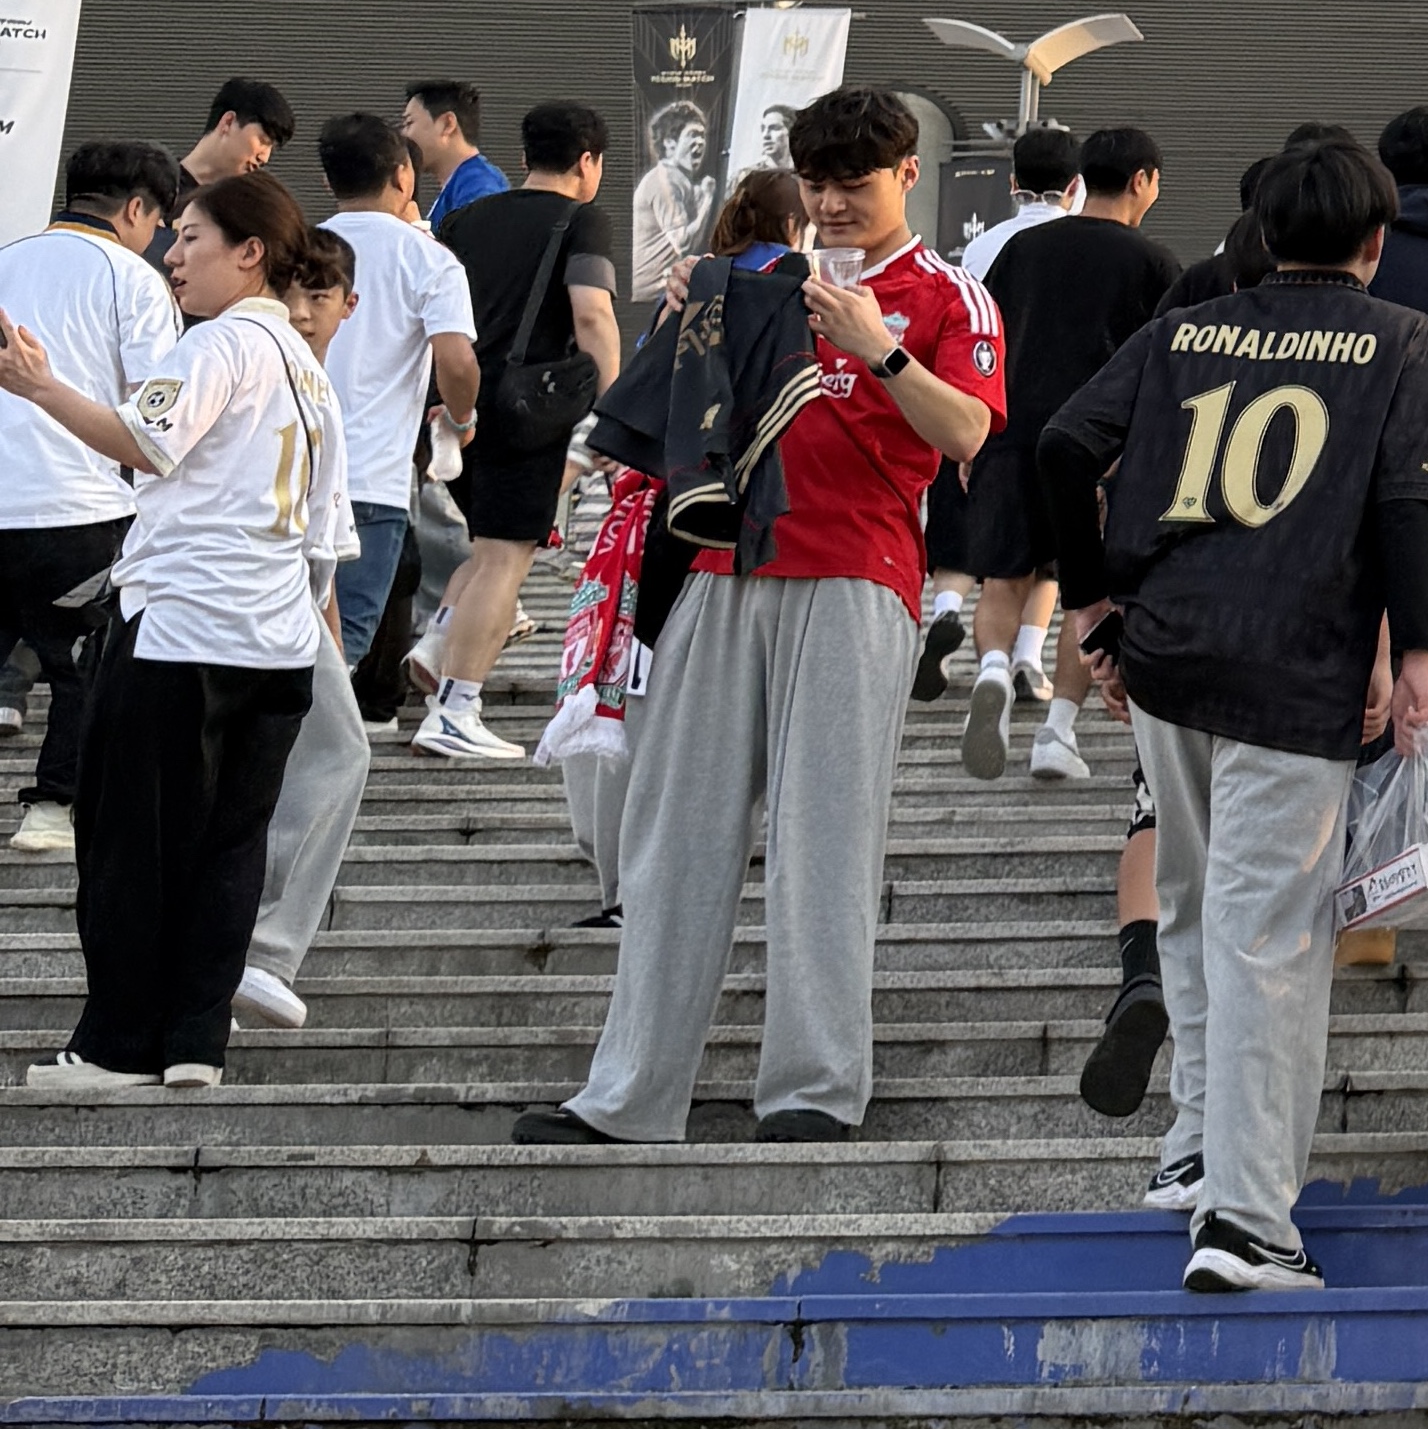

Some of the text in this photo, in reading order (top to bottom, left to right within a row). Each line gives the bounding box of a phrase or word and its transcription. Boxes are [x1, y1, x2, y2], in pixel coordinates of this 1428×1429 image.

[0, 27, 47, 39] ATCH
[1170, 322, 1377, 365] RONALDINHO
[1158, 380, 1330, 529] 10
